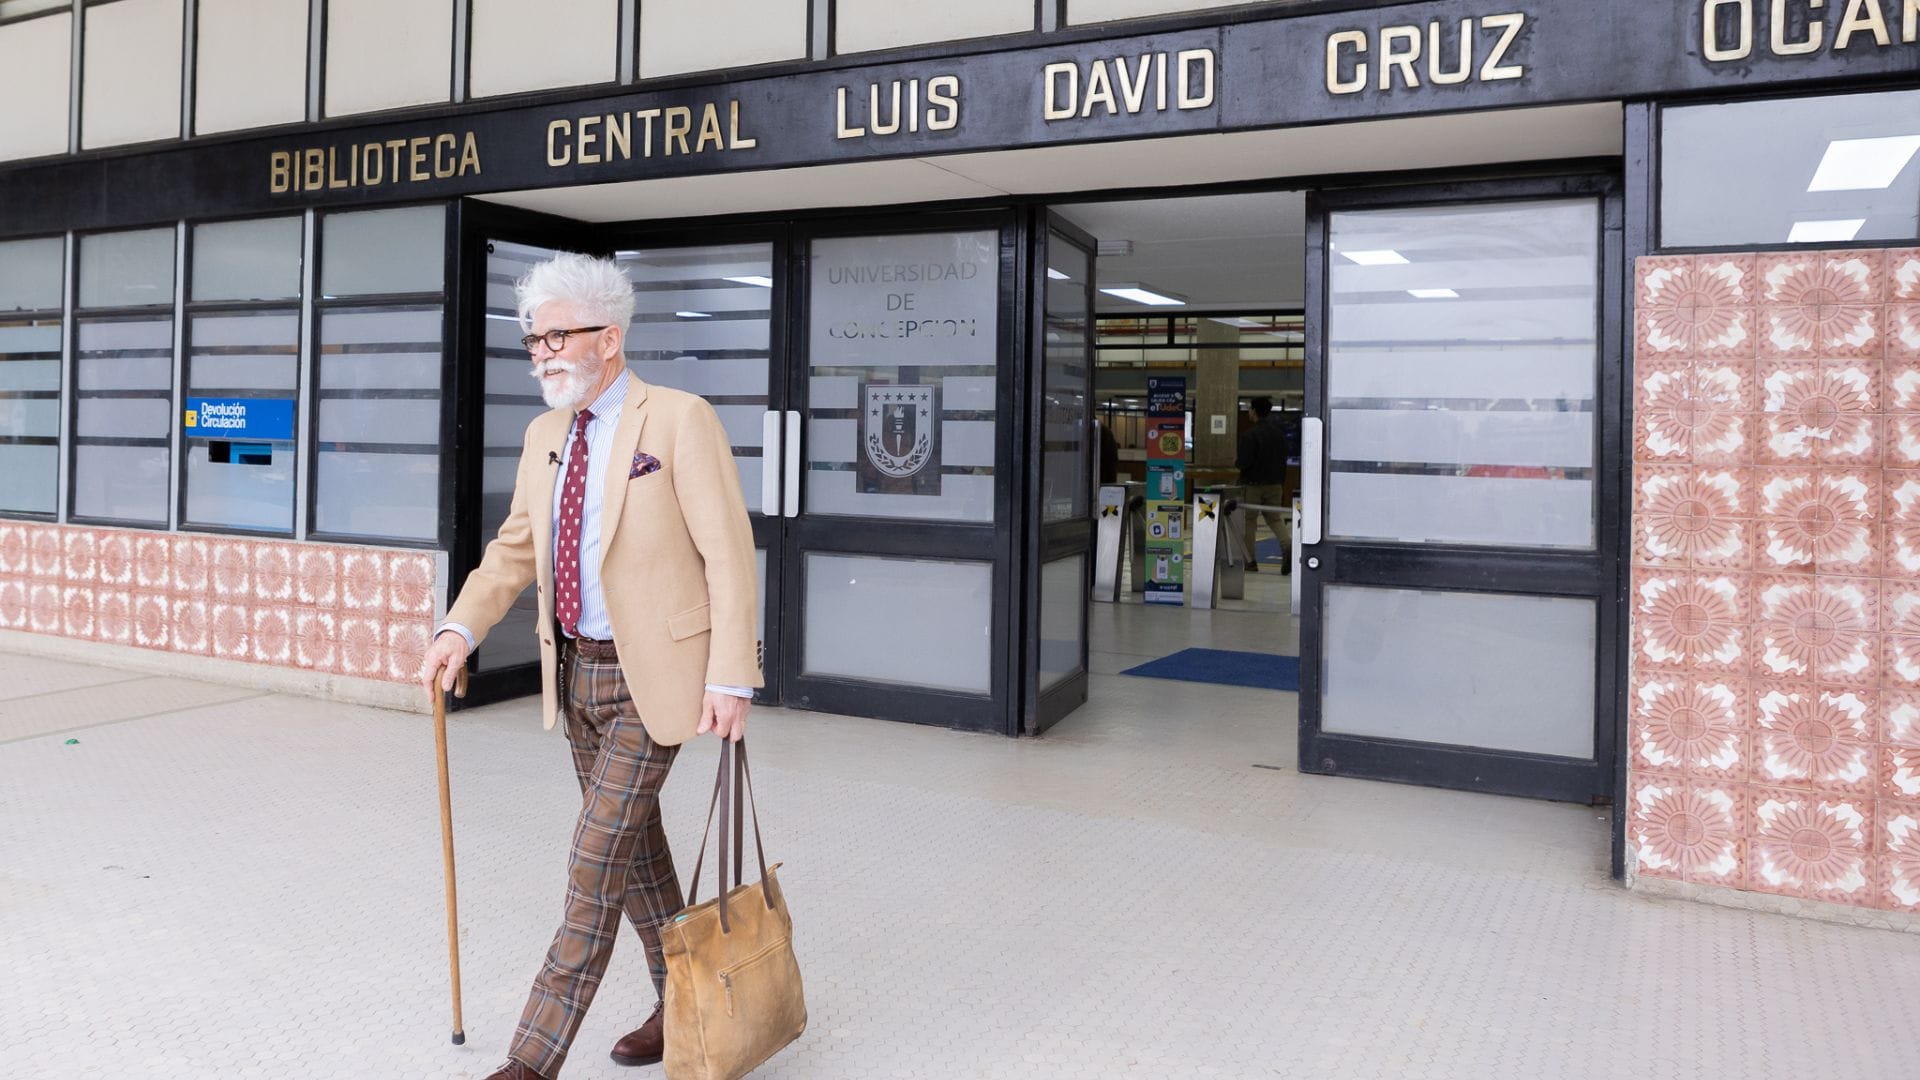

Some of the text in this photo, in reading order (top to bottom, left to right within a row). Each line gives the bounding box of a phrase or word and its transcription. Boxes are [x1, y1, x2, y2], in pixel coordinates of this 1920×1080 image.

[270, 131, 481, 193] BIBLIOTECA
[546, 100, 757, 167] CENTRAL
[836, 75, 959, 140] LUIS
[1044, 48, 1215, 121] DAVID
[1326, 12, 1525, 95] CRUZ
[828, 262, 978, 285] UNIVERSIDAD
[887, 293, 915, 311] DE
[201, 402, 246, 416] Devolución
[201, 414, 246, 428] Circulación
